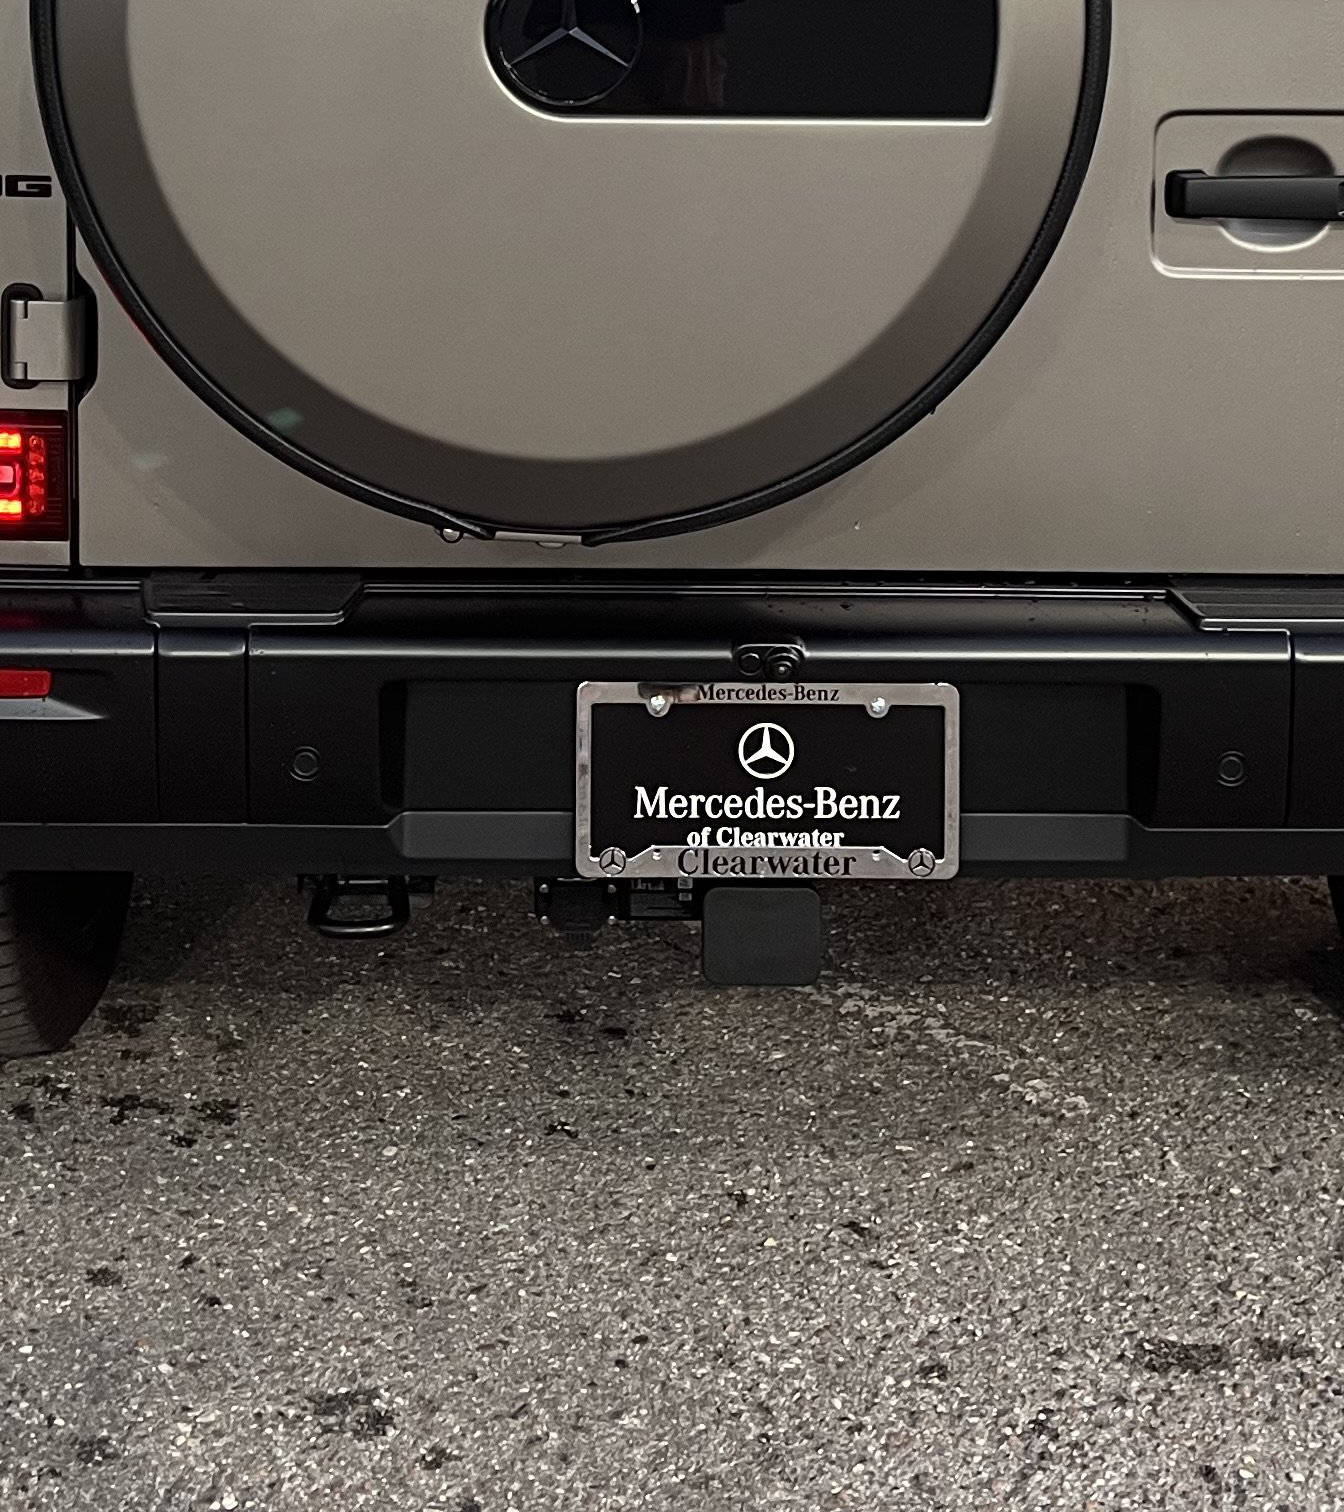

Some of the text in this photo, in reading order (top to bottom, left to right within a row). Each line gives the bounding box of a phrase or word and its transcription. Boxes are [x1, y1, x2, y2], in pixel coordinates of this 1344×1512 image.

[696, 684, 840, 702] Mercedes-Benz
[633, 786, 901, 820] Mercedes-Benz
[686, 826, 845, 847] of Clearwater
[677, 849, 856, 876] Clearwater
